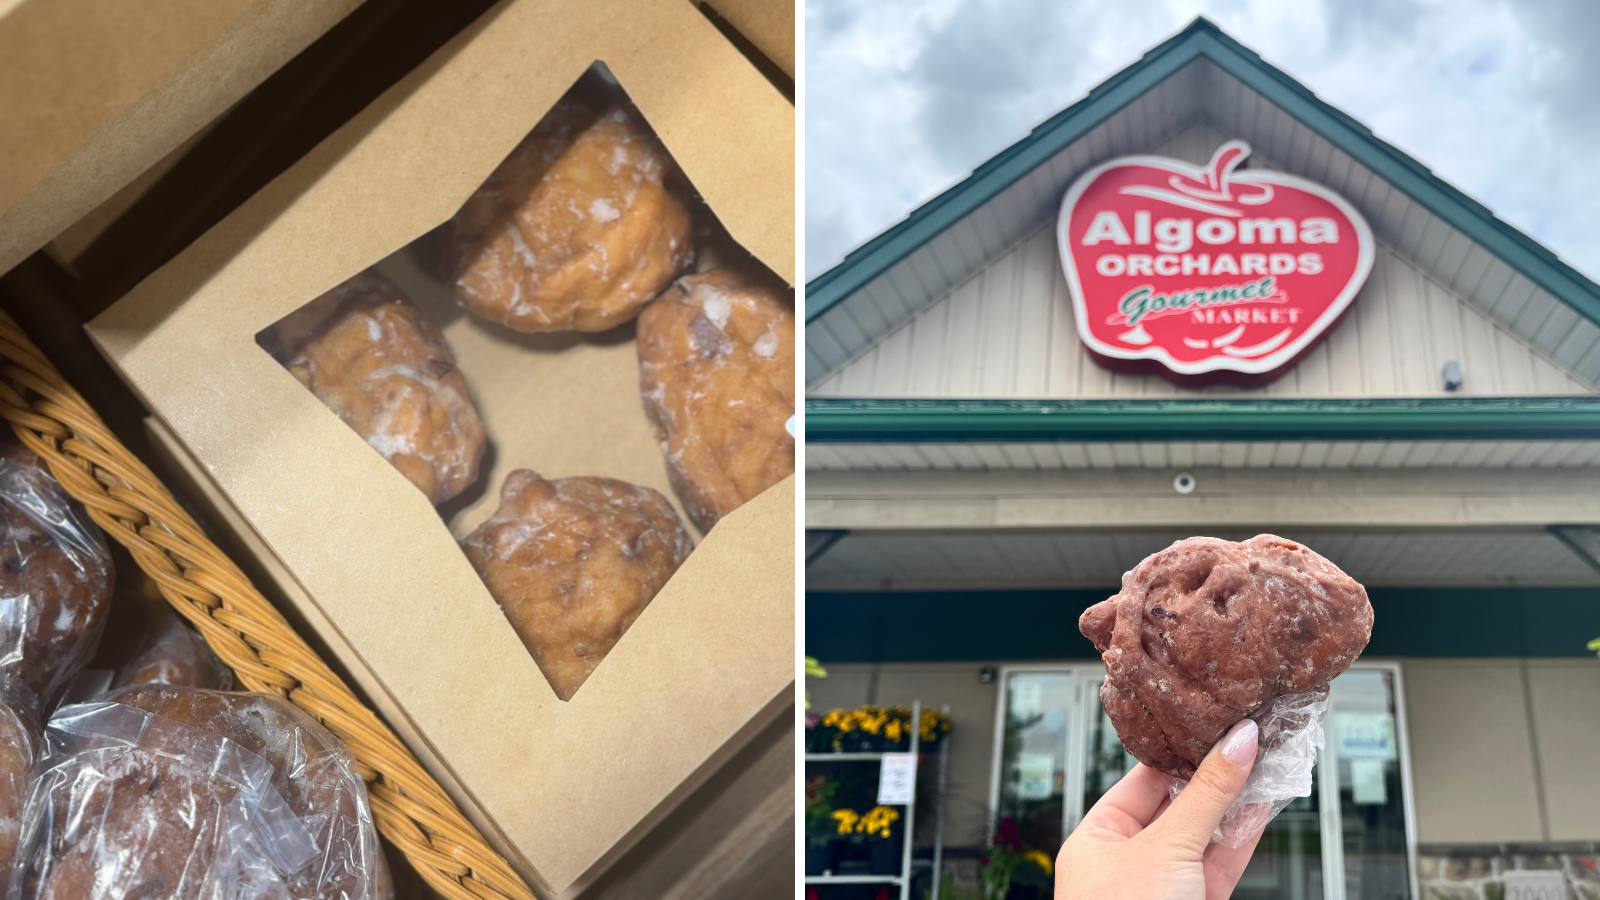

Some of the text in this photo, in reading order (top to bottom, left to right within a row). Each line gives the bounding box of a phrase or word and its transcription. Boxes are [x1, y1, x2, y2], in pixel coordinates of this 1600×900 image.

[1083, 211, 1338, 252] Algoma
[1097, 254, 1323, 276] ORCHARDS
[1119, 276, 1276, 324] Gourmet
[1191, 308, 1301, 324] MARKET
